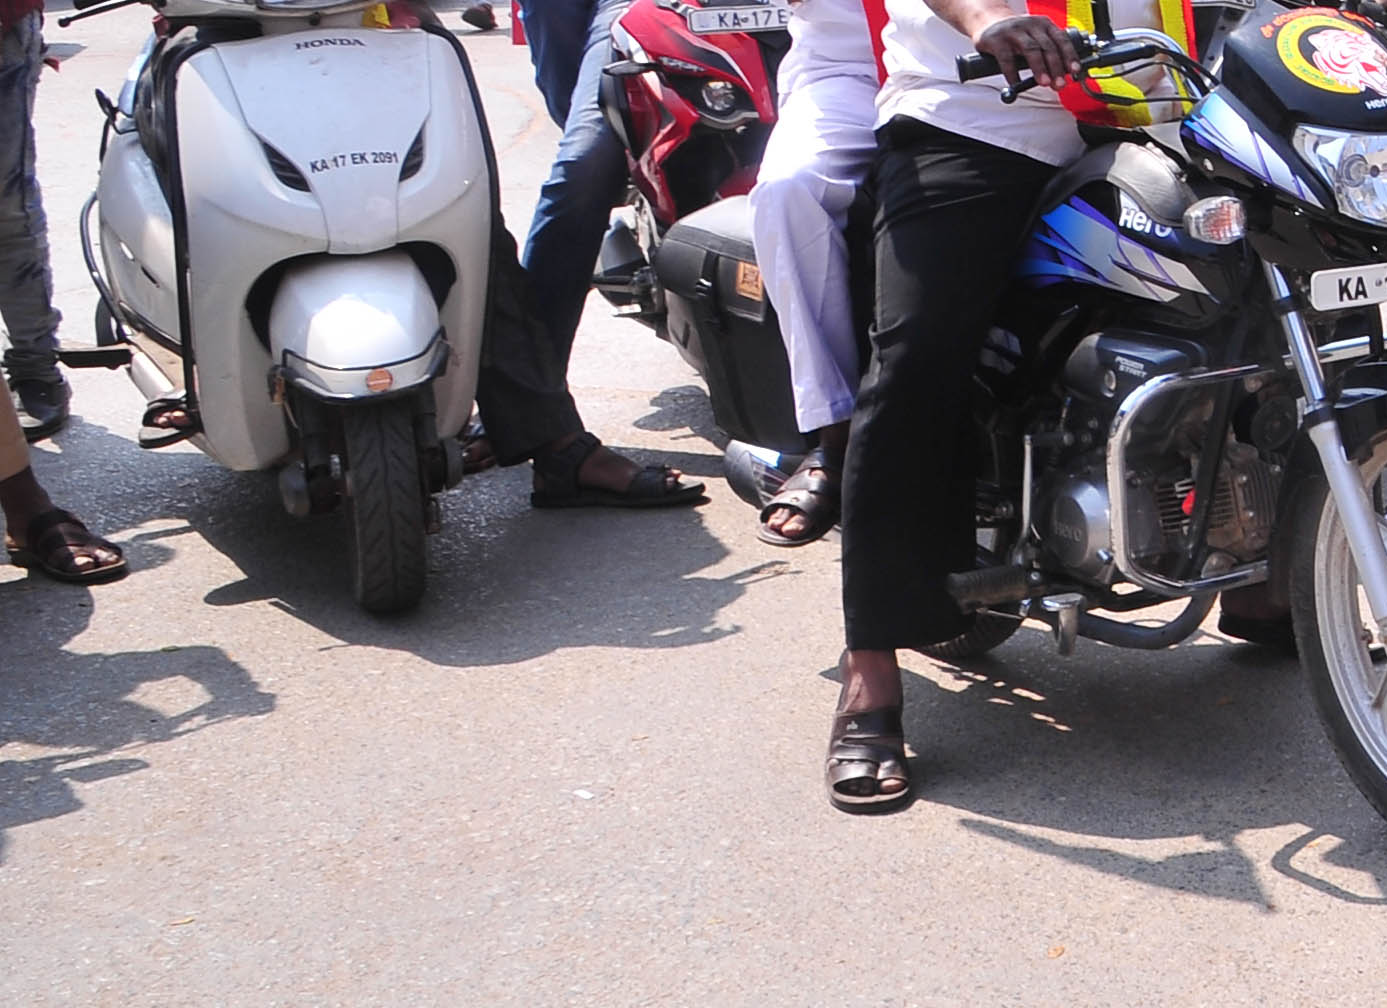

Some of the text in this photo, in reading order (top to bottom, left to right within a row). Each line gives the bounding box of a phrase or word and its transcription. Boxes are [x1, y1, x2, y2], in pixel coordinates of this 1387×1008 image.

[717, 12, 742, 28] KA
[752, 9, 772, 26] 17
[295, 38, 368, 50] HONDA
[310, 151, 399, 173] KA 17 EK 2091
[1337, 276, 1369, 302] KA
